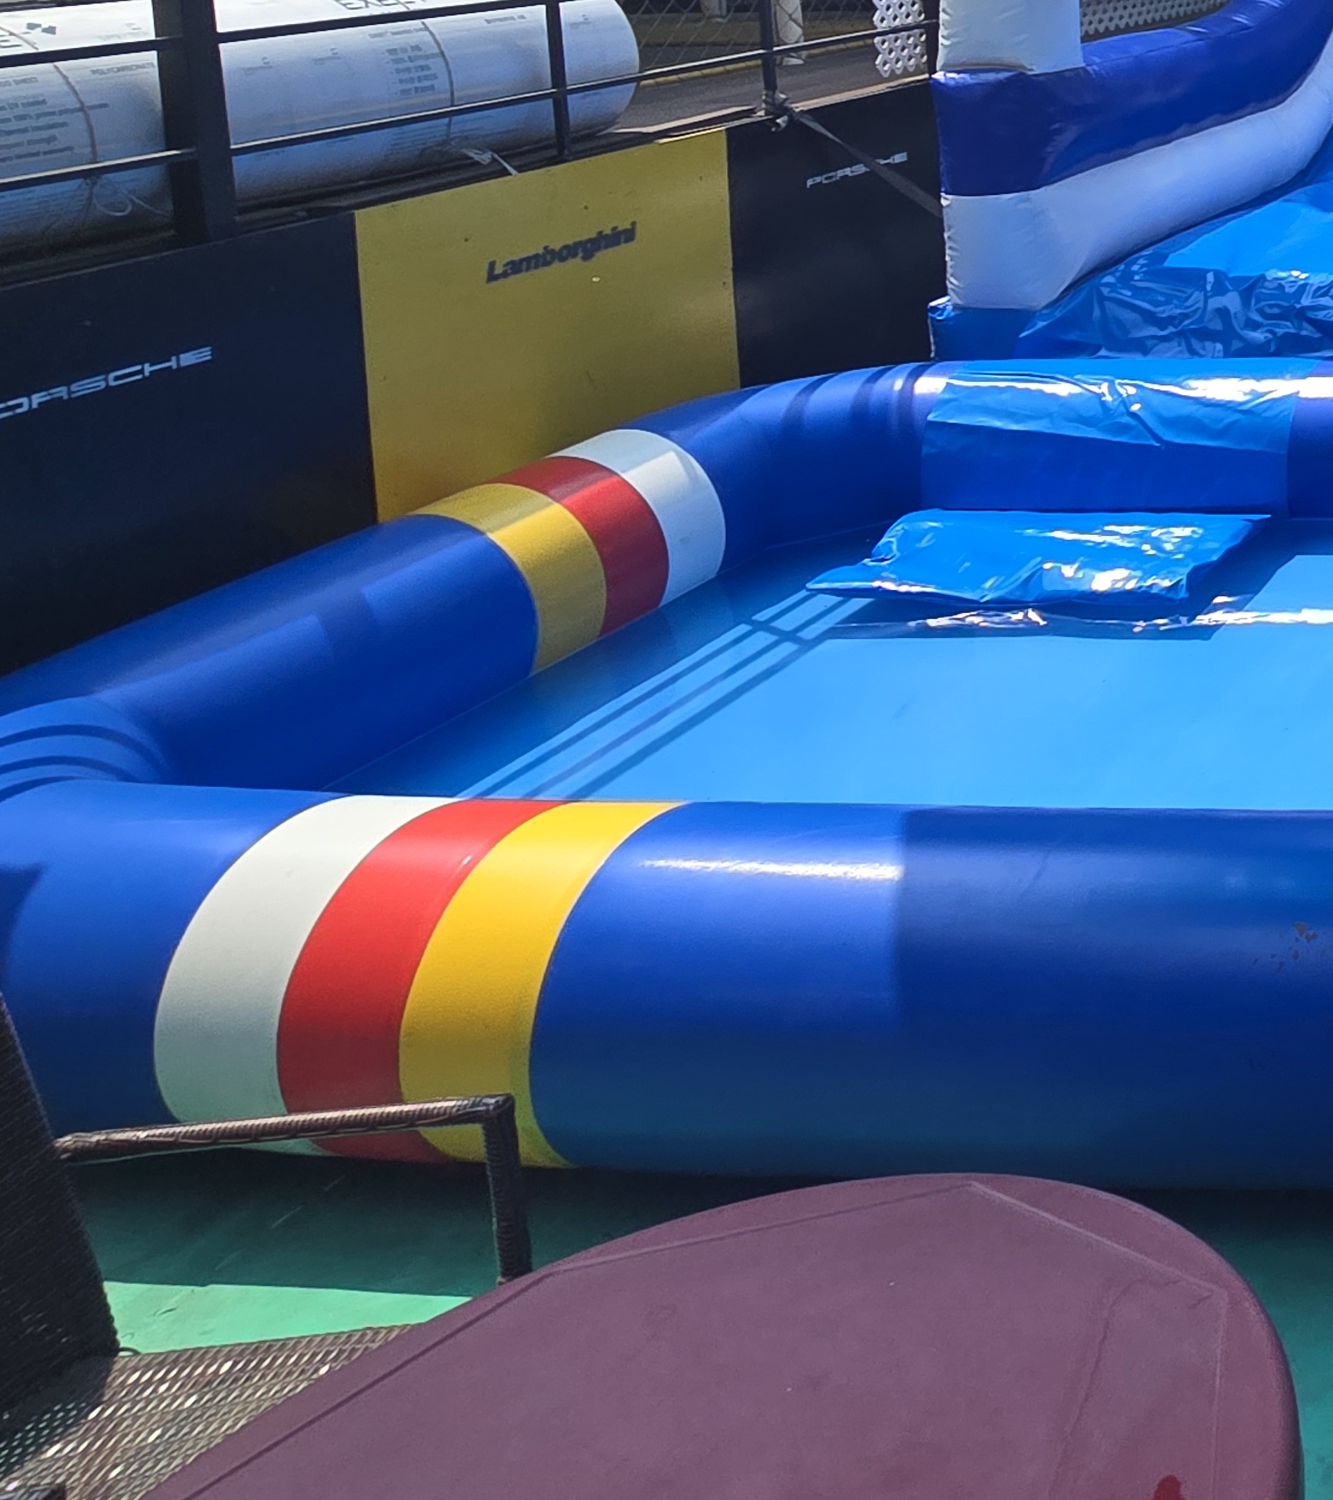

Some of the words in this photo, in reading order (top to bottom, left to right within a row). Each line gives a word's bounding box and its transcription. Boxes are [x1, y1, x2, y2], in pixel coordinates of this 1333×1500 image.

[806, 151, 908, 188] PORSHE
[486, 220, 637, 284] Lamborghini
[0, 346, 212, 419] ORSCHE
